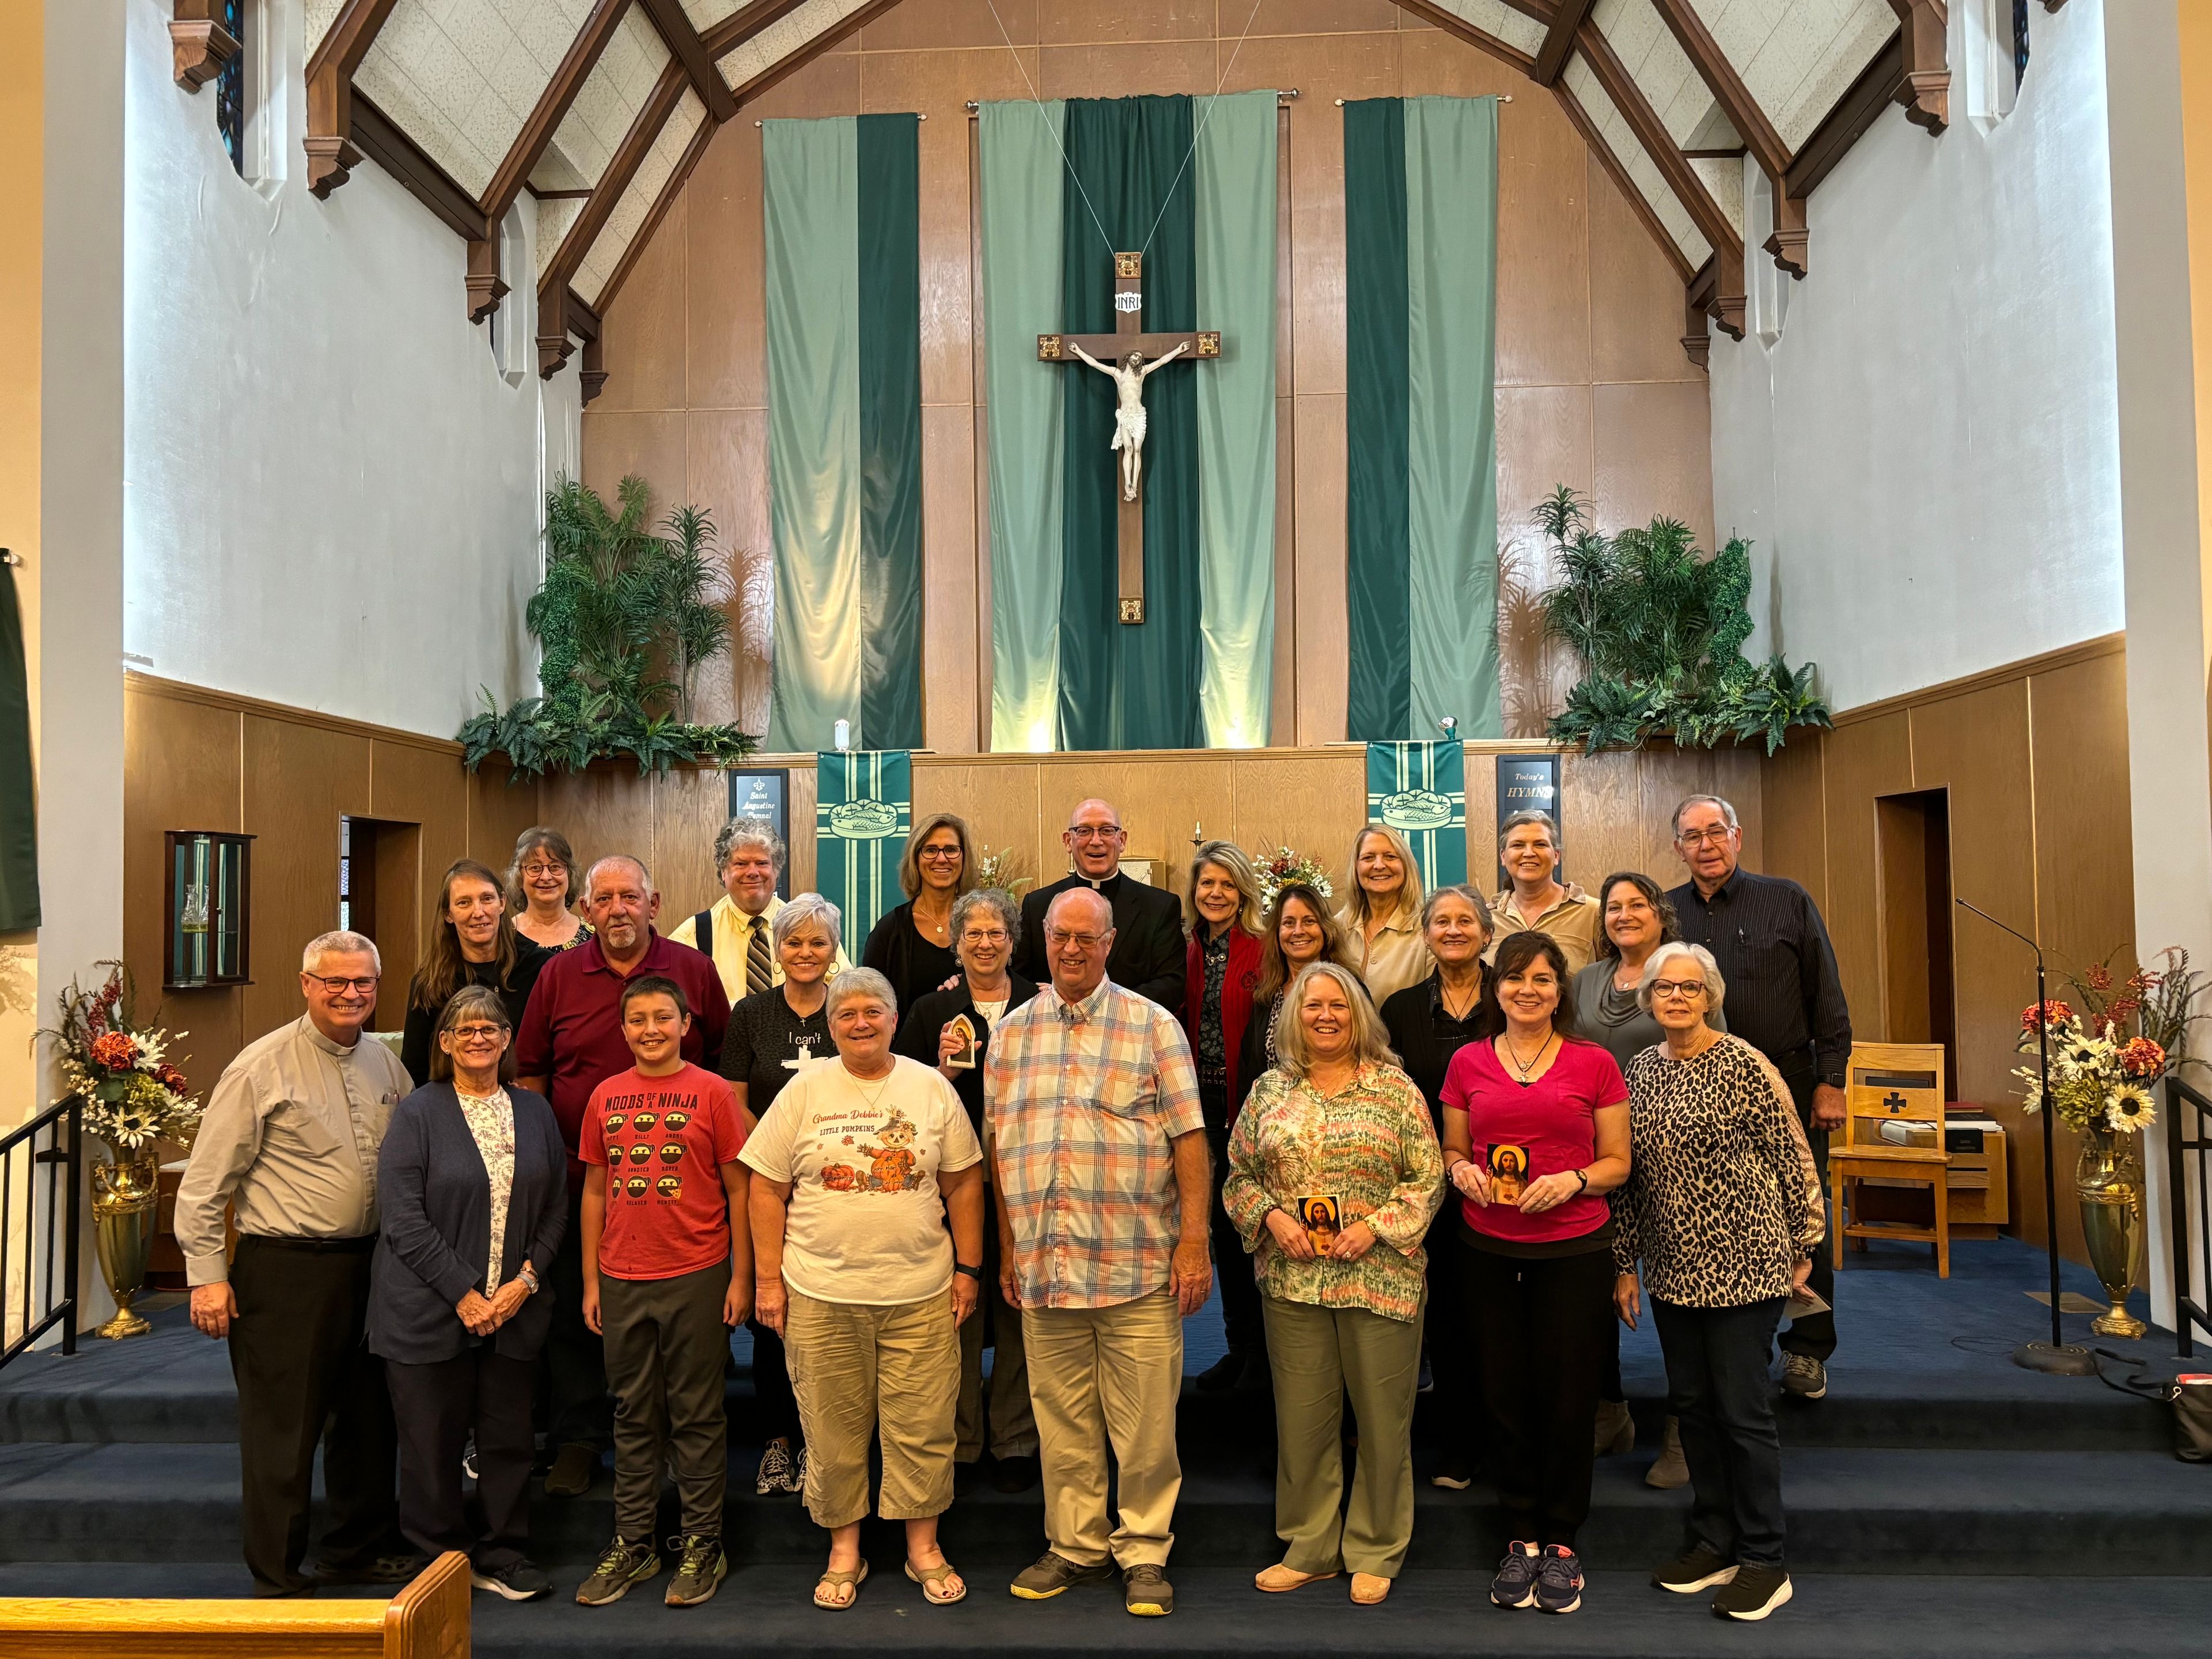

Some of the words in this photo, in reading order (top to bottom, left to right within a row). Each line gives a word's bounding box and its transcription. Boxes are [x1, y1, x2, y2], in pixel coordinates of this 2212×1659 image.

[1118, 297, 1139, 309] INRI
[1515, 773, 1544, 781] Today's
[750, 791, 768, 800] Saint
[742, 801, 775, 810] Augustine
[789, 1031, 792, 1043] I
[795, 1032, 821, 1045] can't
[605, 1093, 645, 1112] MOODS
[647, 1093, 657, 1101] OF
[658, 1093, 698, 1110] NINJA
[813, 1113, 849, 1124] Grandma
[850, 1109, 884, 1120] Debbie's
[820, 1127, 839, 1136] LITTLE
[842, 1125, 875, 1133] PUMPKINS
